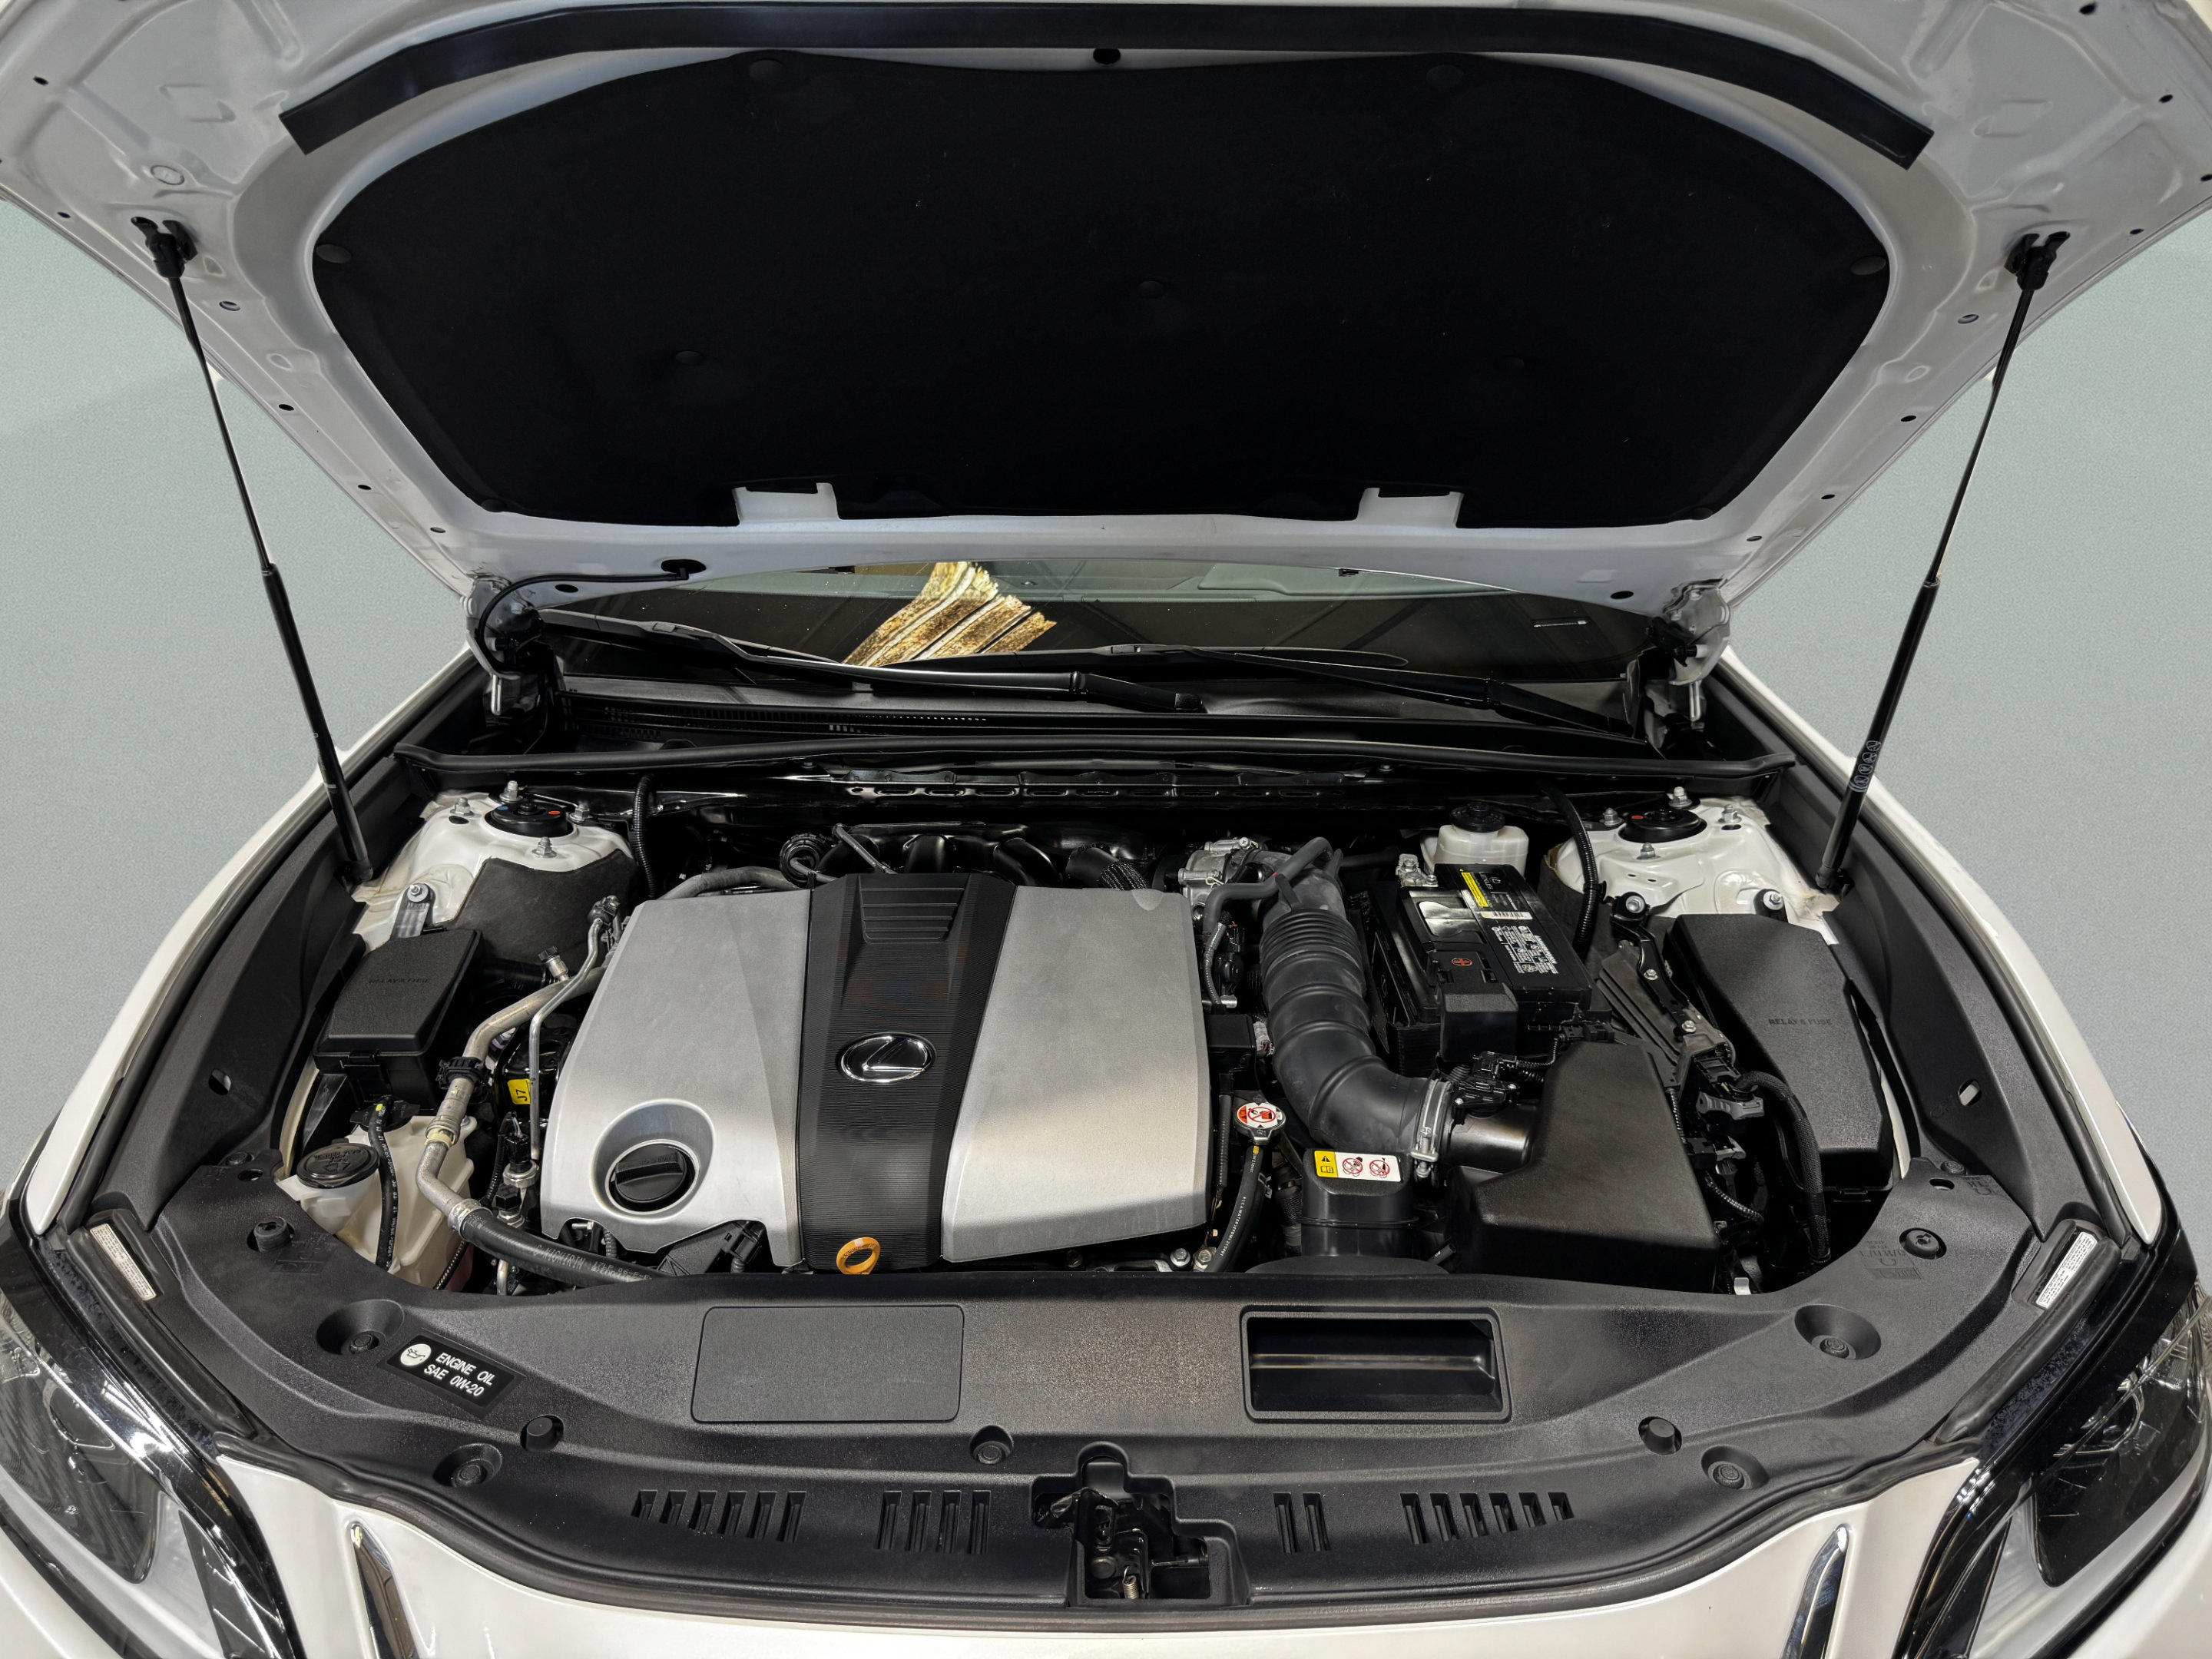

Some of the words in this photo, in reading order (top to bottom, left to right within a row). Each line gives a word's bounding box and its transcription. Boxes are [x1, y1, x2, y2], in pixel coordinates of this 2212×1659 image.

[515, 1089, 528, 1101] J7
[424, 1364, 449, 1380] SAE
[449, 1375, 485, 1397] 0W-20
[435, 1352, 476, 1376] ENGINE
[477, 1370, 496, 1386] OIL
